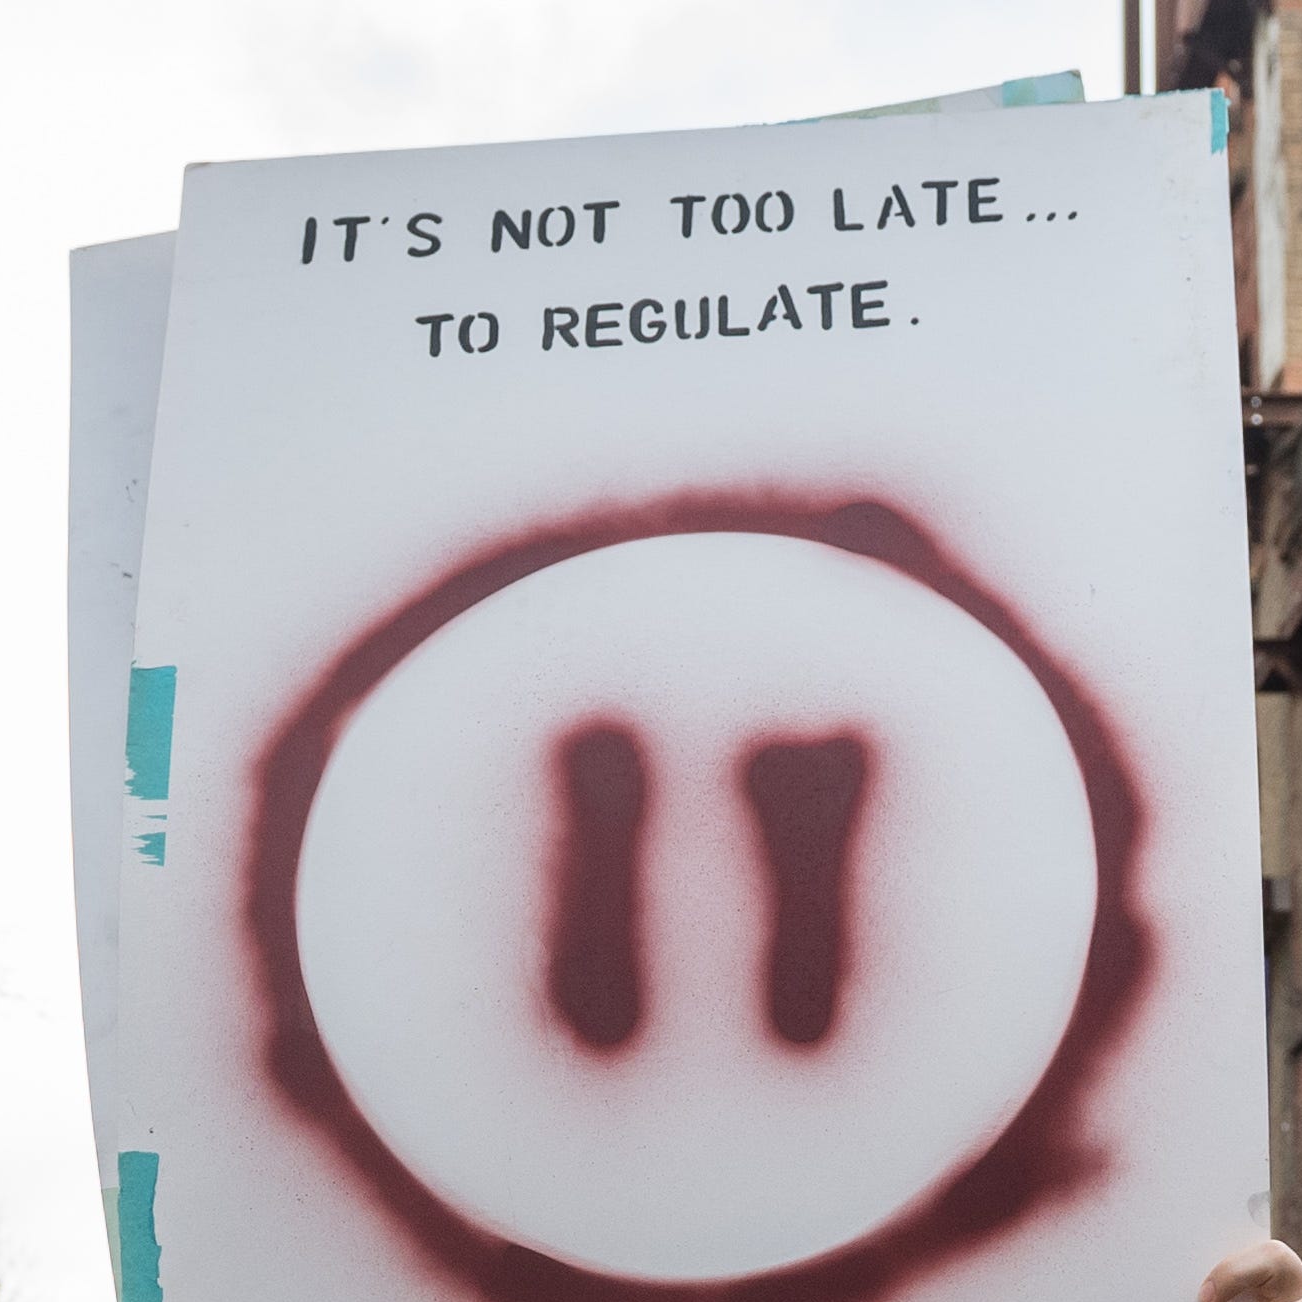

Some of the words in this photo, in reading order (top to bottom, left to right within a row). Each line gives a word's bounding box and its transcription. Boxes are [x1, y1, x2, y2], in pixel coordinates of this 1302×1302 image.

[301, 213, 442, 264] IT'S
[490, 200, 620, 253] NOT
[670, 190, 796, 239] TOO
[834, 177, 1080, 232] LATE...
[415, 310, 500, 358] TO
[540, 280, 922, 352] REGULATE.
